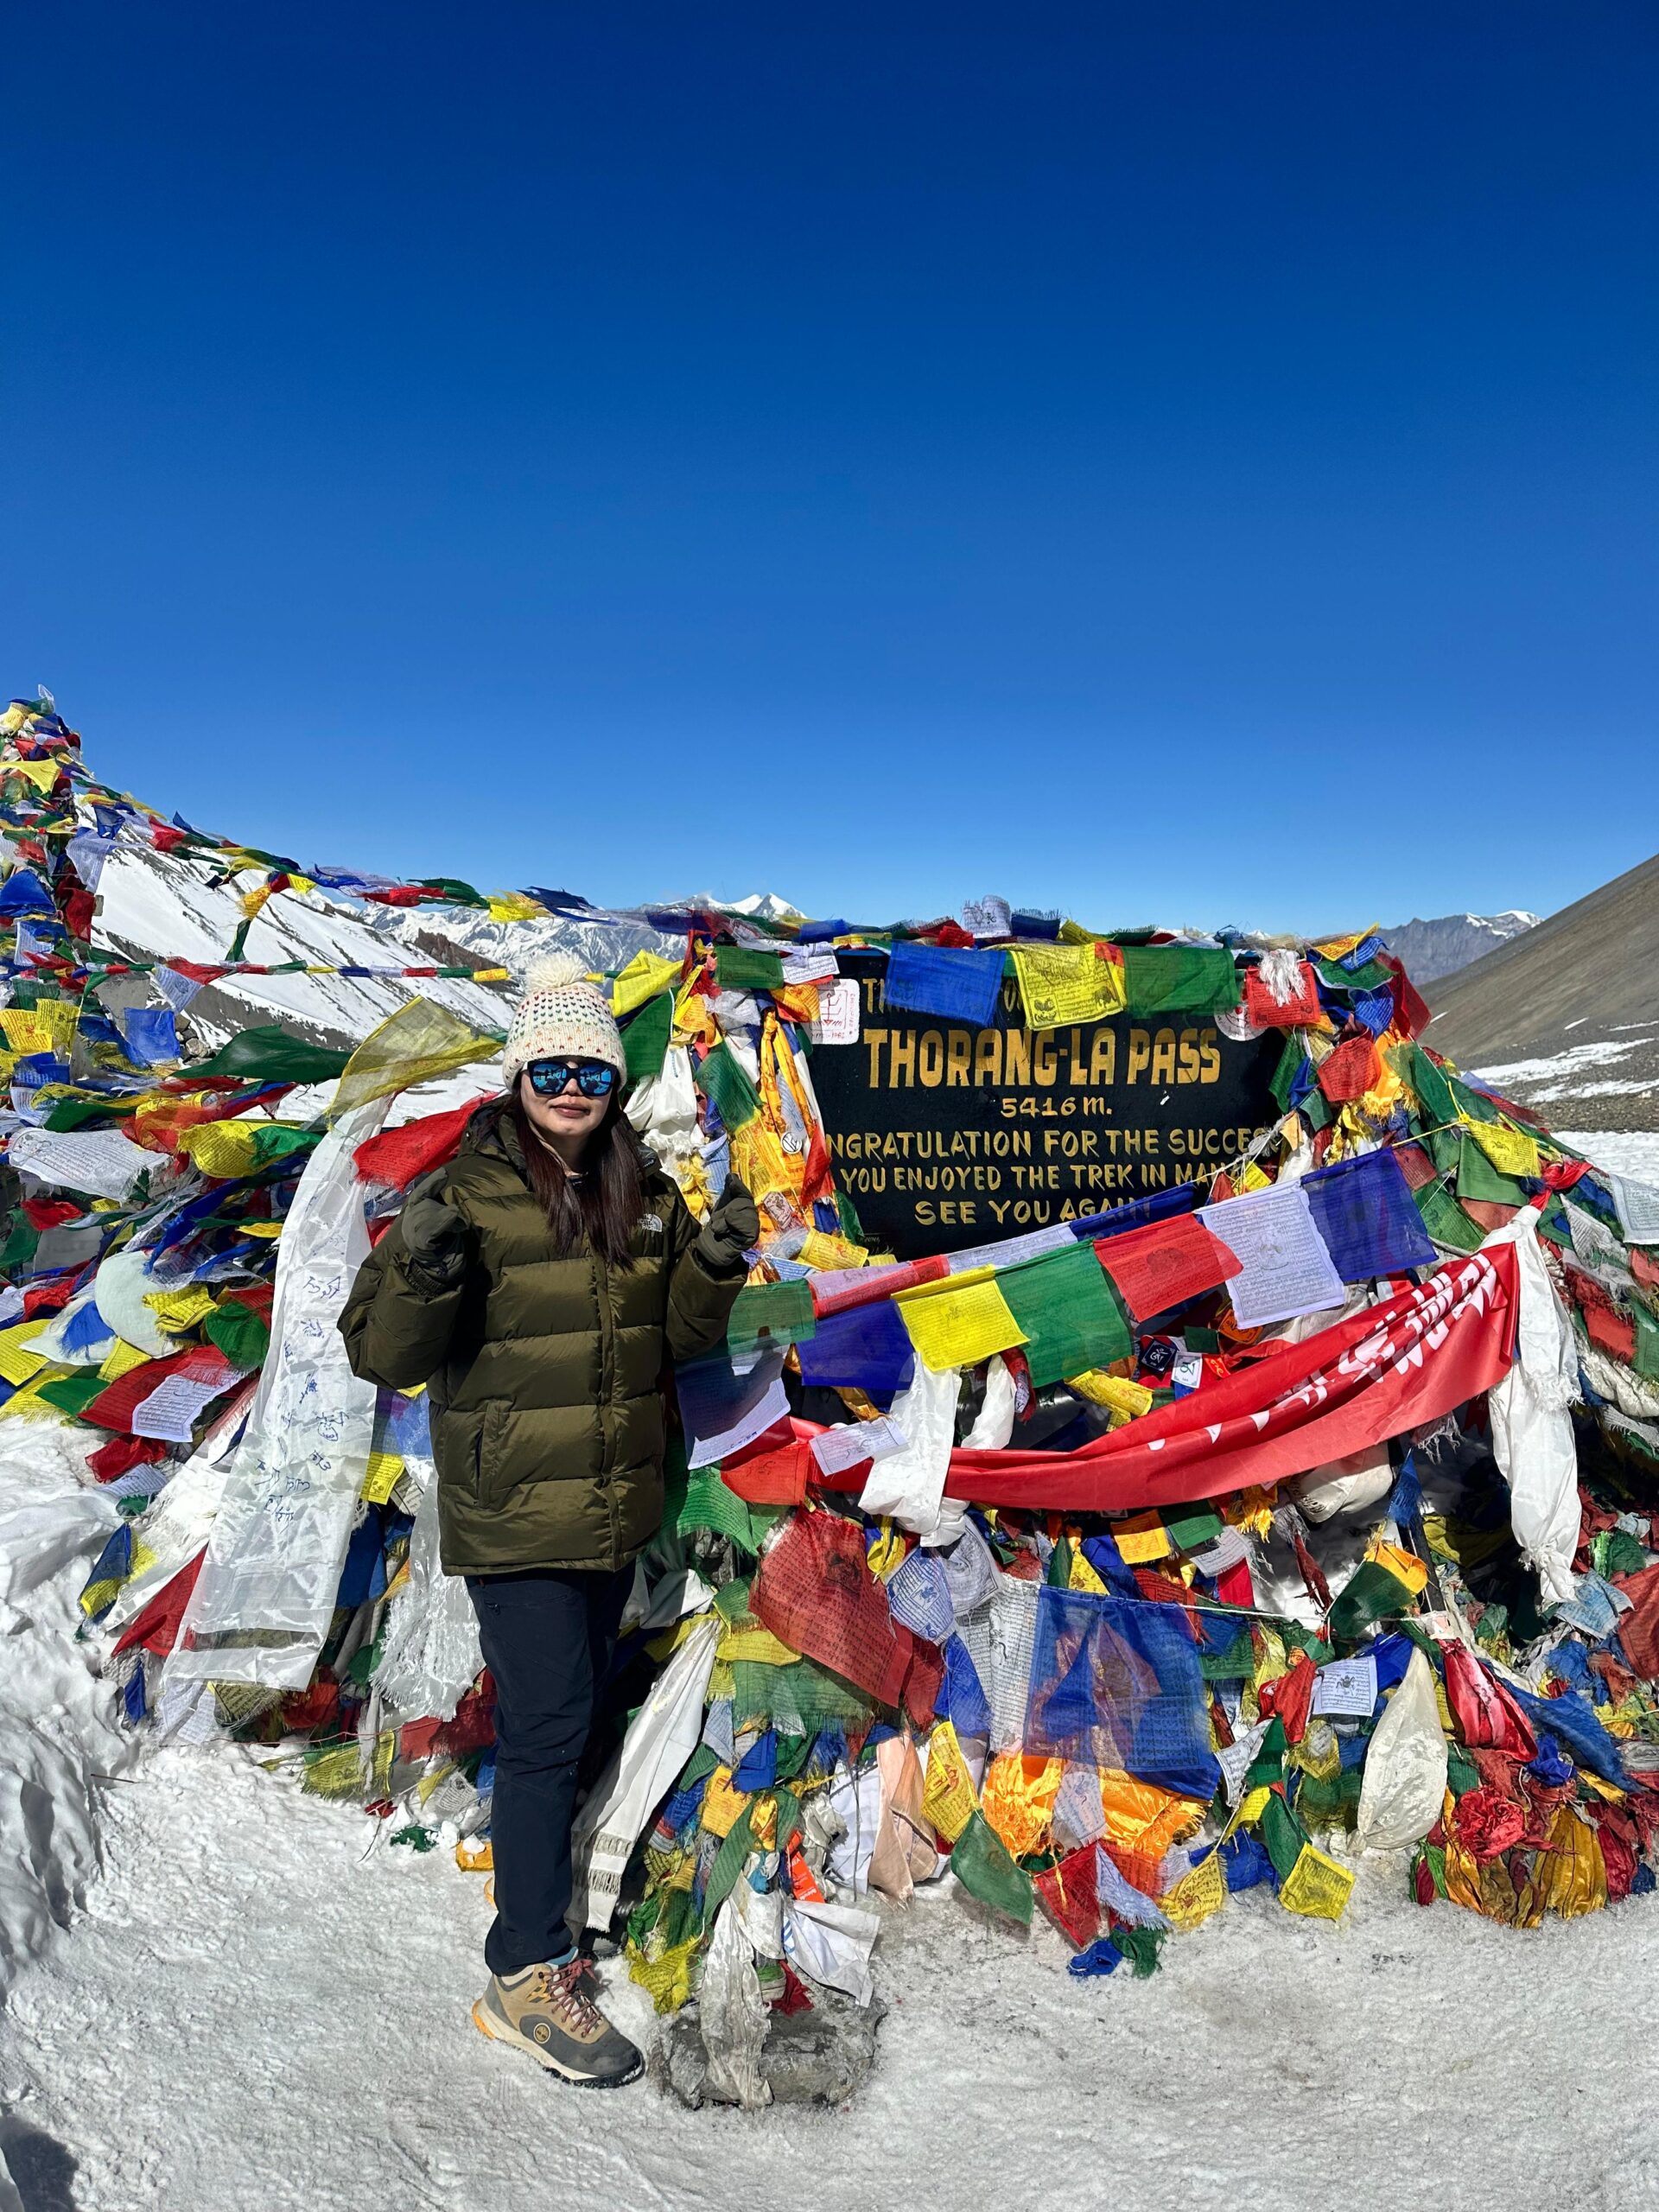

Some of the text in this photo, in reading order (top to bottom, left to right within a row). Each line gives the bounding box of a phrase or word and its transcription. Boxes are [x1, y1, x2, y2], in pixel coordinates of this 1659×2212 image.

[863, 1027, 1116, 1089] THORANG-LA
[1126, 1027, 1222, 1085] PASS
[1000, 1096, 1077, 1119] 5416
[825, 1127, 1279, 1163] NGRATULATION FOR THE SUCCE
[840, 1166, 887, 1195] YOU
[893, 1166, 1001, 1192] ENJOYED
[1011, 1166, 1061, 1190] THE
[1070, 1164, 1135, 1192] TREK
[1141, 1163, 1166, 1188] IN
[914, 1199, 977, 1226] SEE
[988, 1198, 1051, 1225] YOU
